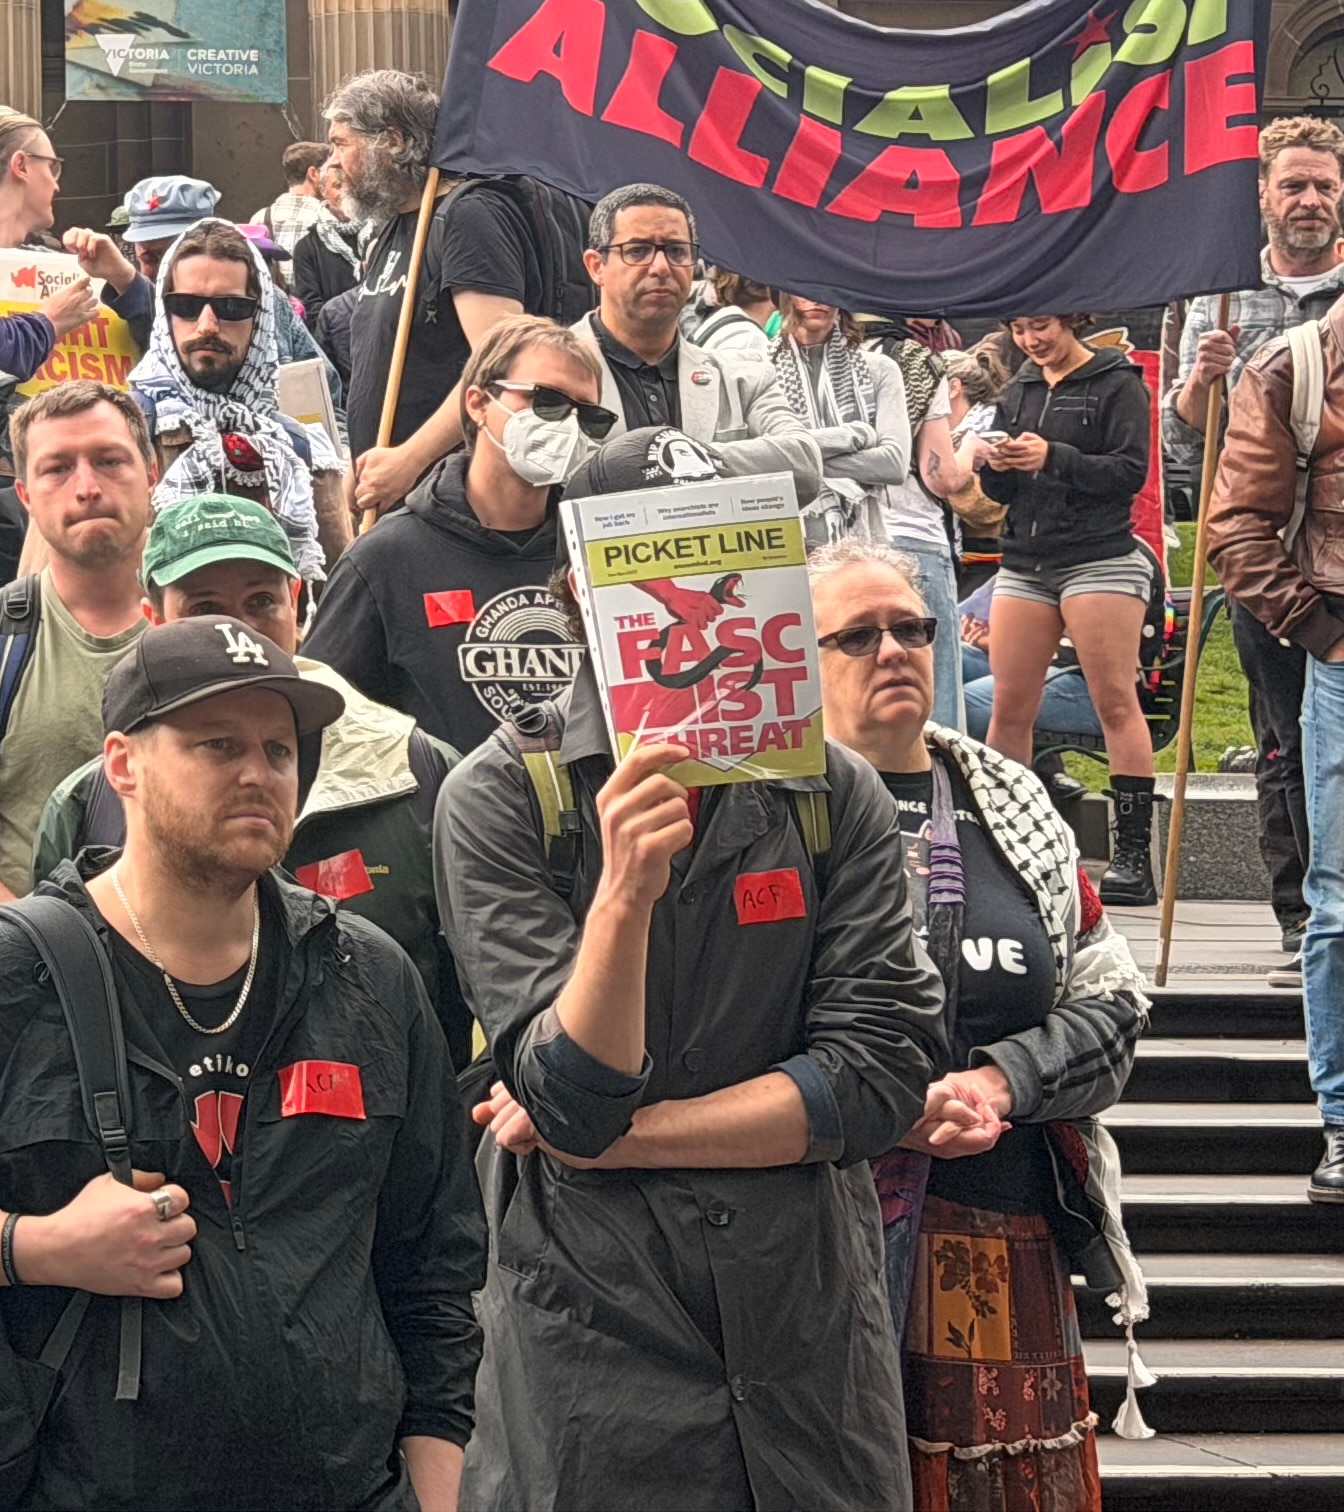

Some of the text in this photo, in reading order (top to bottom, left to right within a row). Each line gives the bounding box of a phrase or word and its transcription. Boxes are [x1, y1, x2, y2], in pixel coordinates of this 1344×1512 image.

[104, 48, 170, 61] VICTORIA
[186, 48, 259, 61] CREATIVE
[187, 62, 259, 76] VICTORIA
[603, 527, 786, 568] PICKET LINE
[475, 593, 530, 639] GHANDA
[613, 612, 656, 630] THE
[214, 623, 269, 667] LA
[616, 612, 806, 680] FASC
